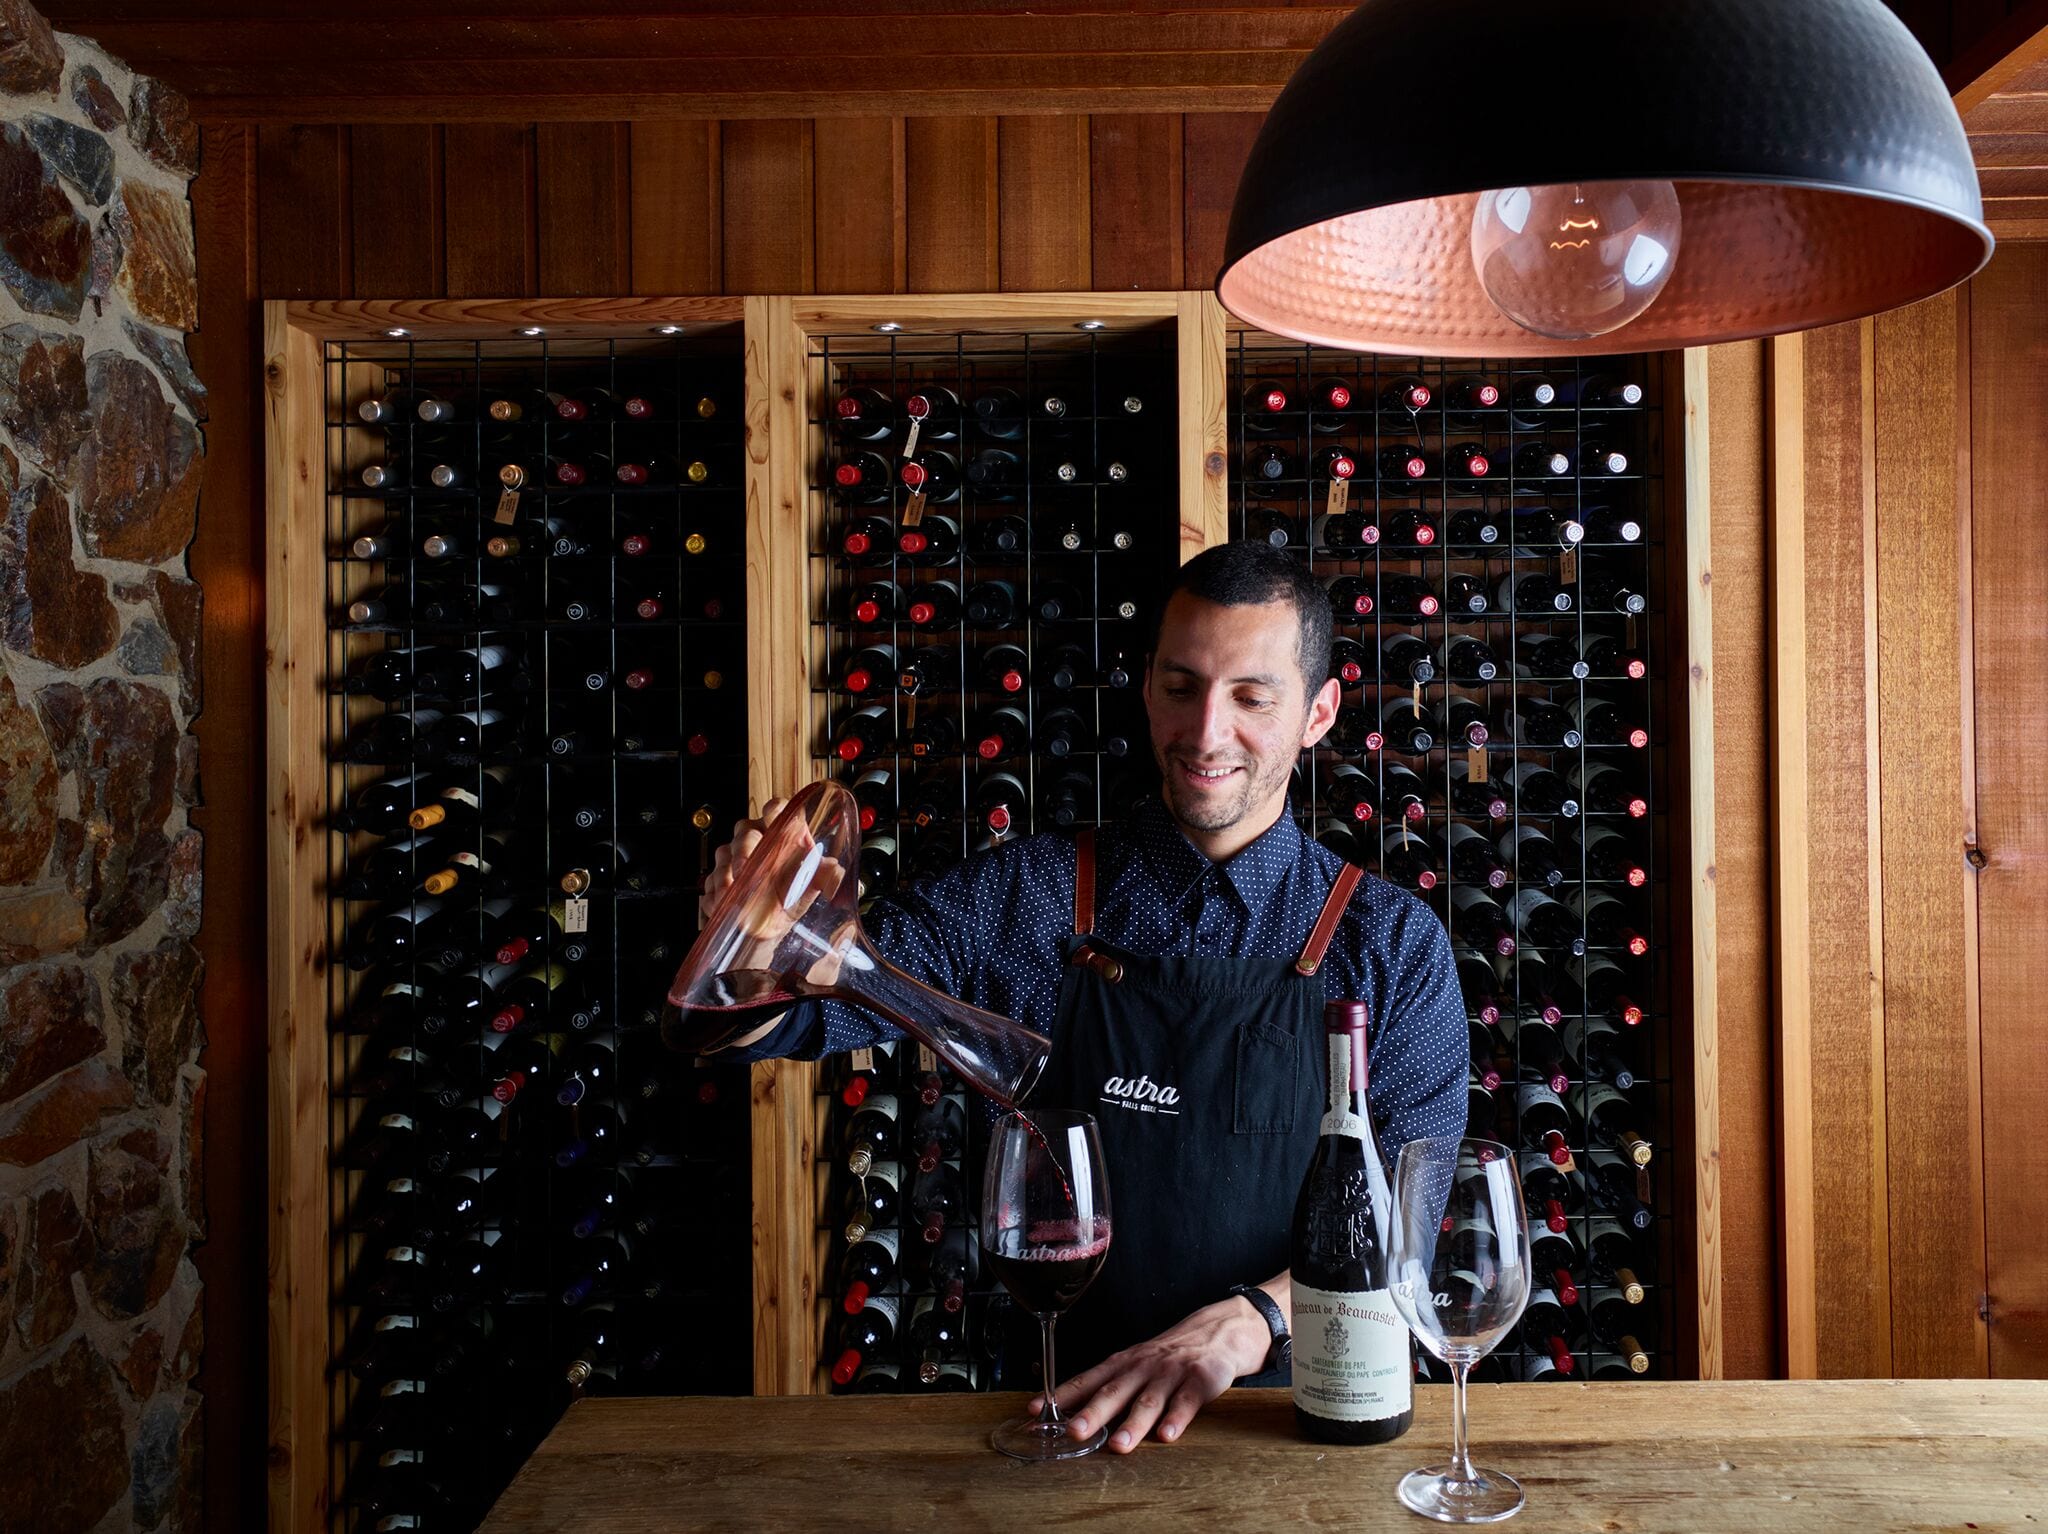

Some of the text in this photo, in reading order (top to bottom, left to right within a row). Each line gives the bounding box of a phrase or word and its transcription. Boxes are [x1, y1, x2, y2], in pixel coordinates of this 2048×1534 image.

[1104, 1075, 1180, 1105] astra
[1121, 1100, 1138, 1111] FALLS
[1327, 1118, 1357, 1130] 2006
[1016, 1241, 1074, 1263] astra
[1398, 1282, 1453, 1308] asra
[1323, 1305, 1333, 1315] de
[1336, 1301, 1397, 1326] Beaucastel
[1353, 1361, 1367, 1370] PAPE
[1357, 1370, 1370, 1379] PAPE
